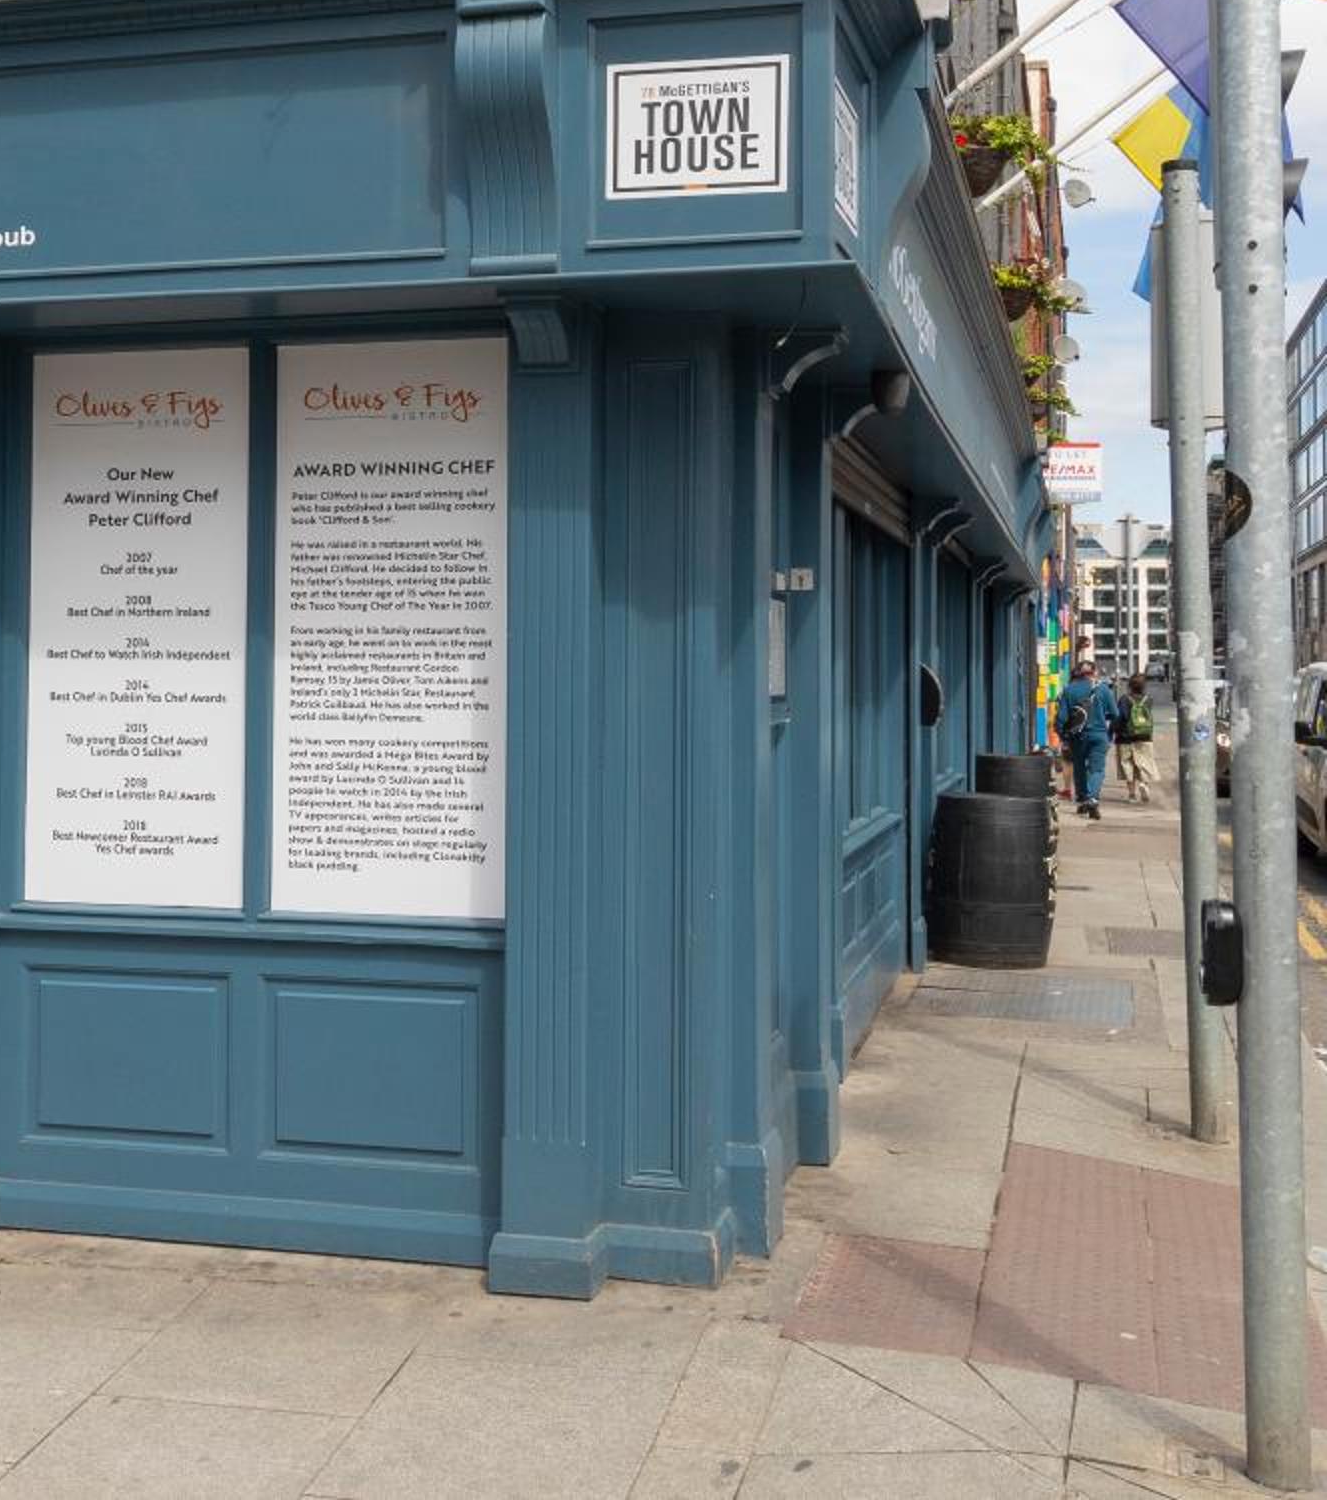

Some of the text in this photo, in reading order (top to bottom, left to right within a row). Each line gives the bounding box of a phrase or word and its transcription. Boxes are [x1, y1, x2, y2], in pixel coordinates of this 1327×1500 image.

[659, 81, 750, 97] McGETTIGAN'S
[641, 96, 750, 137] TOWN
[634, 134, 760, 175] HOUSE
[57, 390, 135, 417] Olives
[167, 391, 223, 429] Figs
[304, 383, 386, 411] Olives
[423, 384, 482, 422] Figs
[106, 467, 174, 481] Our New
[293, 459, 495, 477] AWARD WINNING CHEF
[63, 488, 219, 505] Award Winning Chef
[88, 512, 192, 527] Peter Clifford
